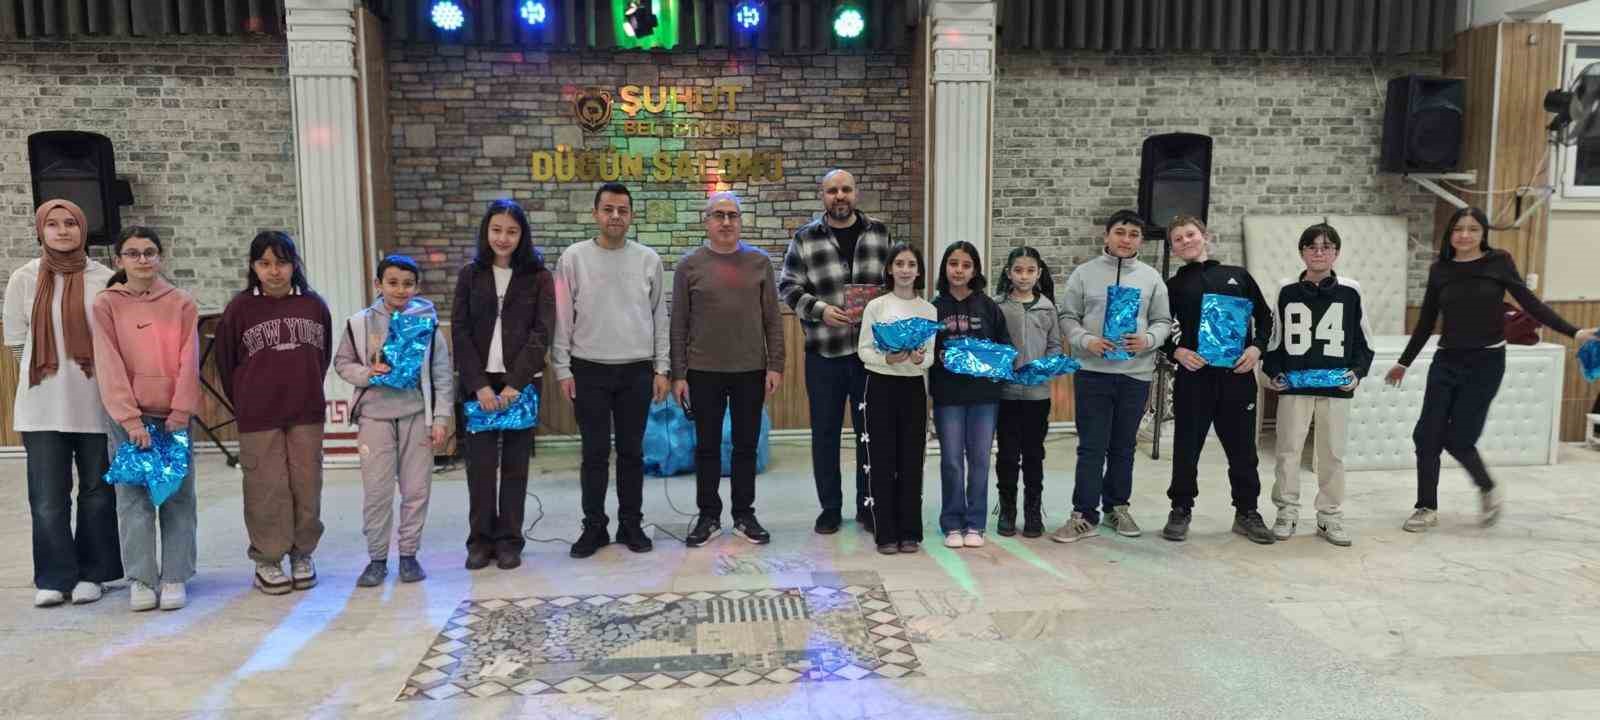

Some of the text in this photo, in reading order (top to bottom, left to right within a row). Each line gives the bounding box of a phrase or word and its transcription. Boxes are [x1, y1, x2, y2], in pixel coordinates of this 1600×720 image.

[619, 84, 743, 117] ŞUHUT
[531, 144, 643, 182] DÜĞÜN
[242, 318, 281, 357] NEW
[1284, 302, 1345, 358] 84
